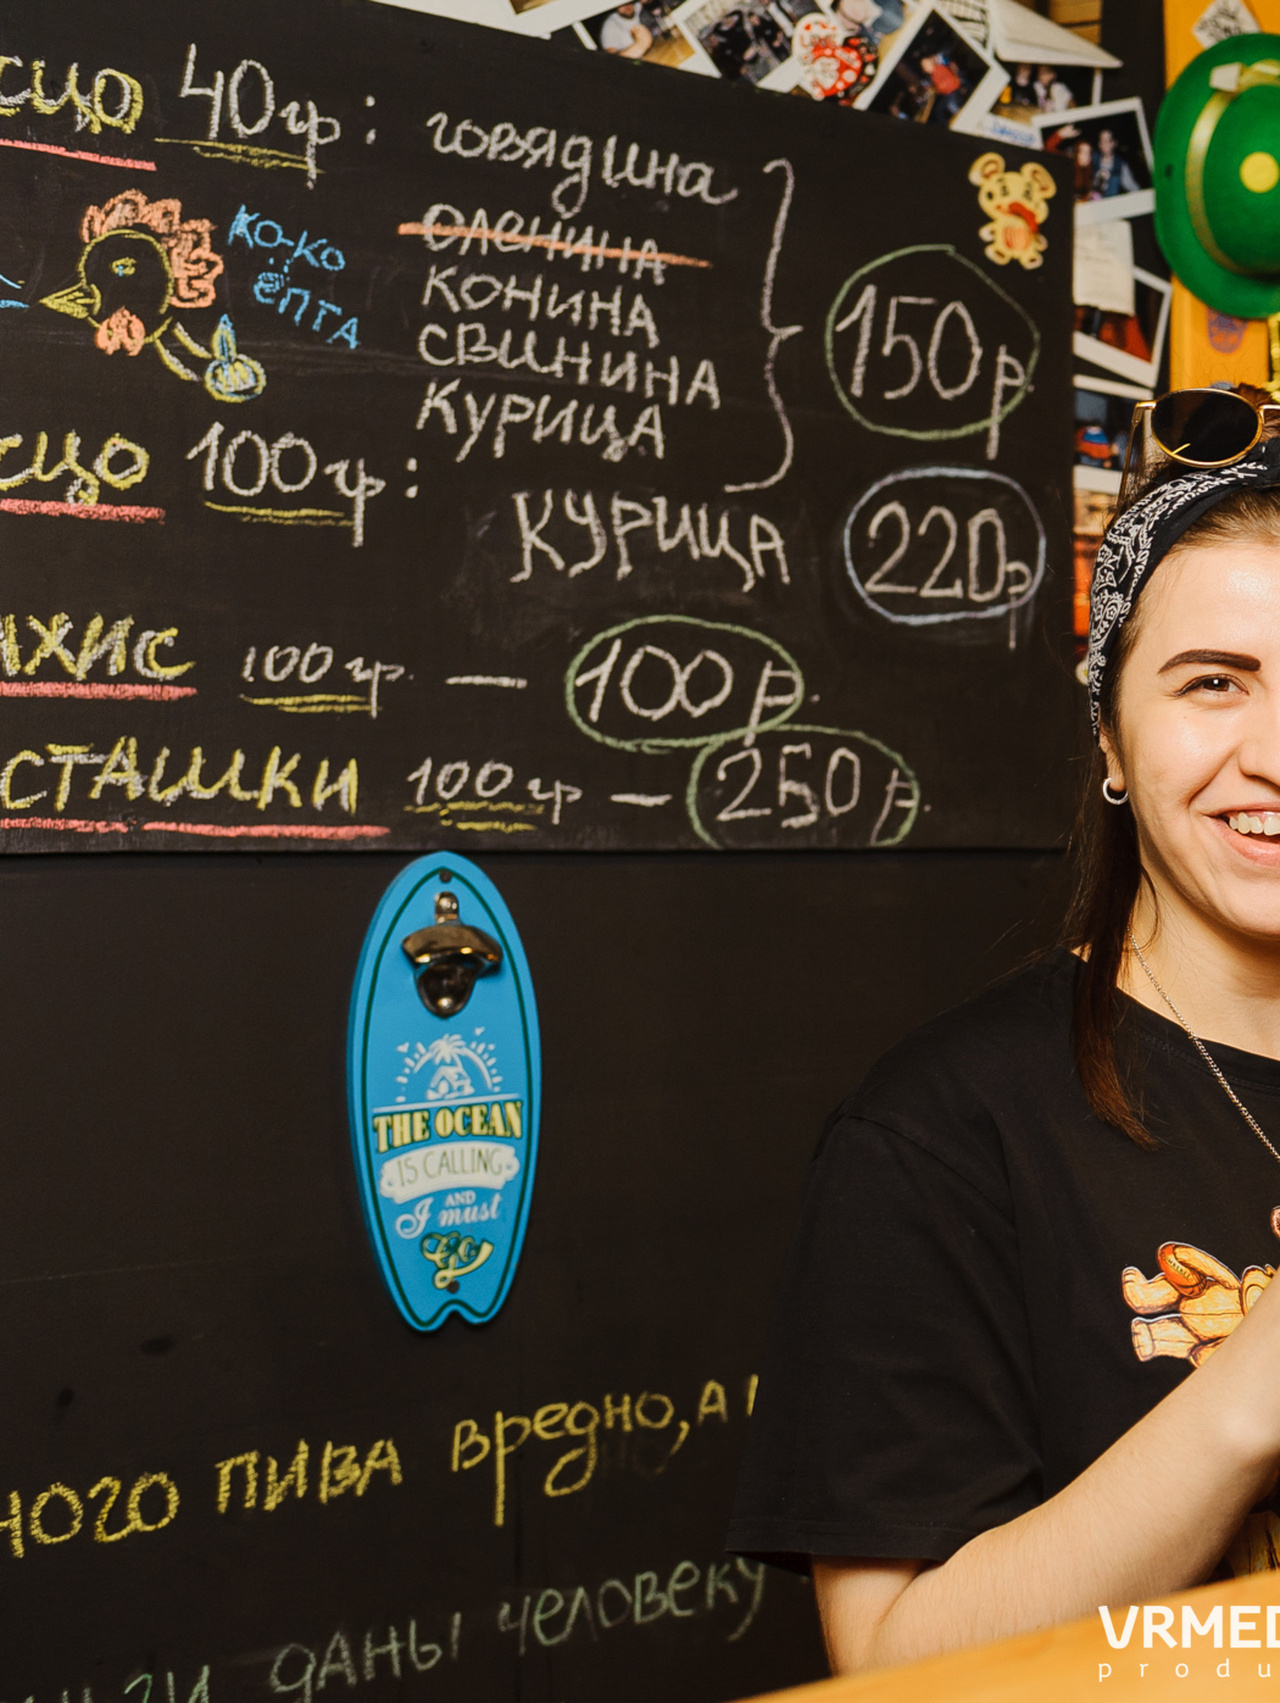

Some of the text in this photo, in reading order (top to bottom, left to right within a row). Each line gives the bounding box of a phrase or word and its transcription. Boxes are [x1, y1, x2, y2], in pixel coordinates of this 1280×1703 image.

[421, 264, 661, 349] КОНИНА
[417, 322, 721, 411] СВИНИНА
[510, 488, 791, 594] КУРИЦА
[372, 1100, 523, 1154] THE OCEAN
[397, 1148, 503, 1188] IS CALLING
[439, 1193, 503, 1228] must
[445, 1190, 477, 1208] AND
